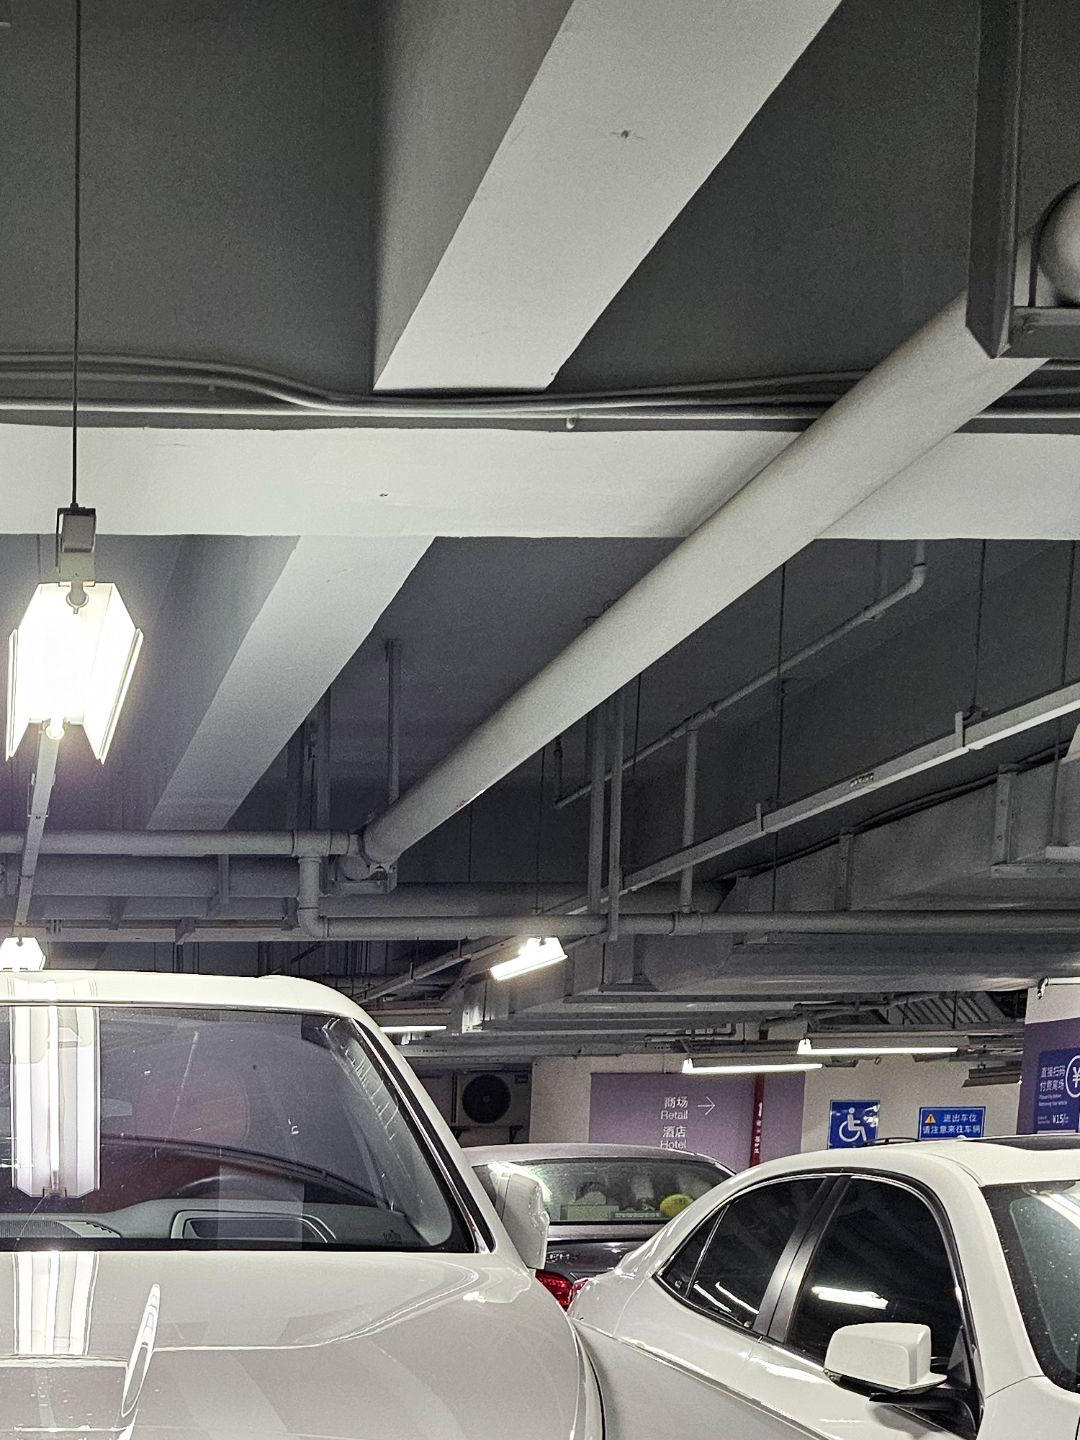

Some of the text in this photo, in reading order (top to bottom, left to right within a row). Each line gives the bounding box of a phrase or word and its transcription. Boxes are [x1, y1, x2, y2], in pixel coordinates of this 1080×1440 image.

[664, 1096, 688, 1109] 商场
[660, 1110, 688, 1120] Retail
[942, 1113, 977, 1123] 进出车位
[662, 1126, 687, 1138] 酒店
[660, 1140, 687, 1149] Hotel
